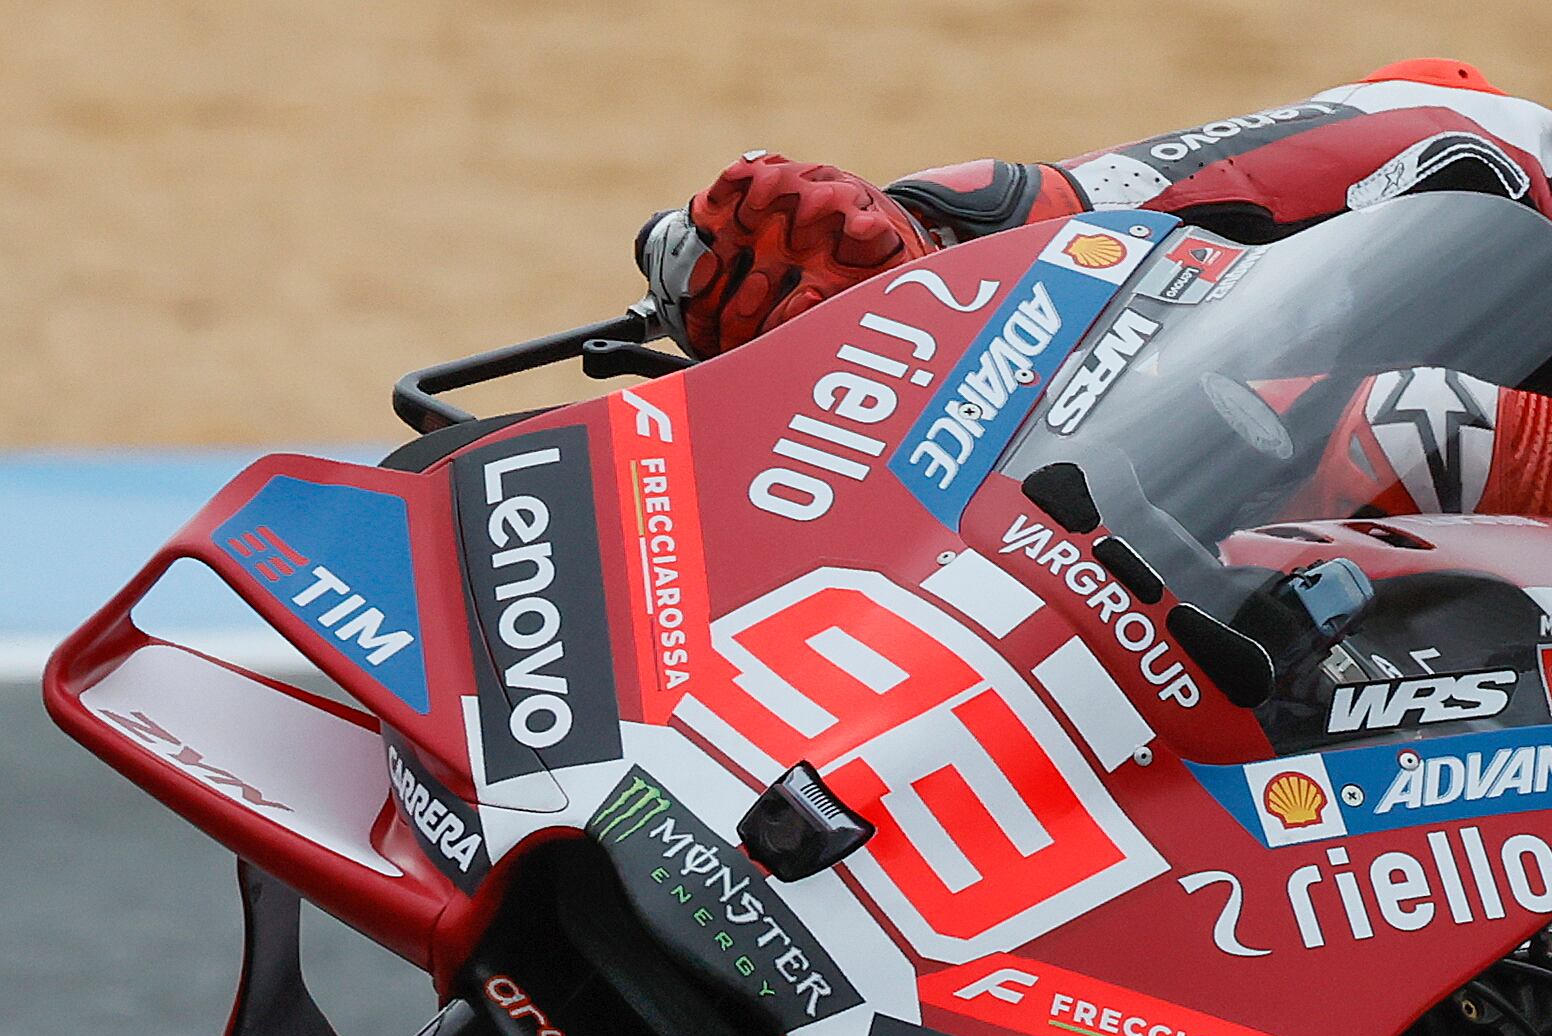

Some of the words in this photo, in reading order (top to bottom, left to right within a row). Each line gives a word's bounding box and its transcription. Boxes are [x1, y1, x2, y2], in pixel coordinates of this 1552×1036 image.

[1150, 104, 1336, 161] Lenovo
[1165, 266, 1200, 298] Lenovo
[748, 312, 937, 521] riello
[909, 281, 1065, 490] ADVANCE
[1045, 311, 1162, 436] WRS
[291, 566, 415, 666] TIM
[484, 447, 573, 748] Lenovo
[640, 457, 690, 690] FRECCIAROSSA
[999, 515, 1201, 710] VARGROUP
[98, 708, 295, 813] ZYN
[1327, 670, 1518, 733] WRS
[387, 744, 486, 873] CARRERA
[650, 866, 776, 999] ENERGY
